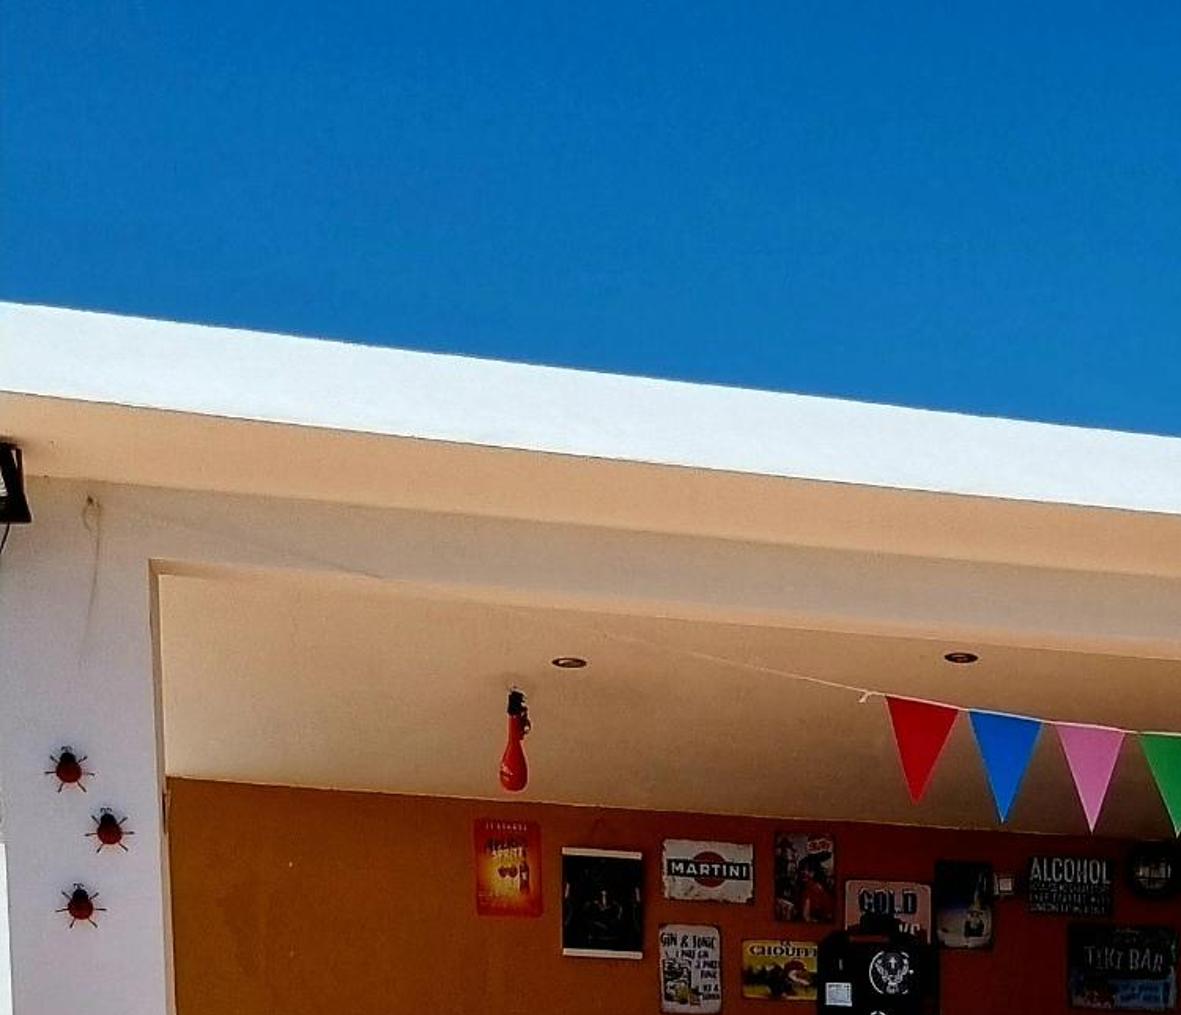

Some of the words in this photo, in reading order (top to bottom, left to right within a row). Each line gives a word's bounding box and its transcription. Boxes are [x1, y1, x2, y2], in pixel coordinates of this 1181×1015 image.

[671, 862, 747, 877] MARTINI
[1029, 857, 1112, 885] ALCOHOL
[859, 889, 917, 914] COLD
[661, 933, 677, 946] GIN
[680, 936, 689, 948] &
[1083, 945, 1124, 970] TIKI
[1129, 948, 1164, 973] BAR
